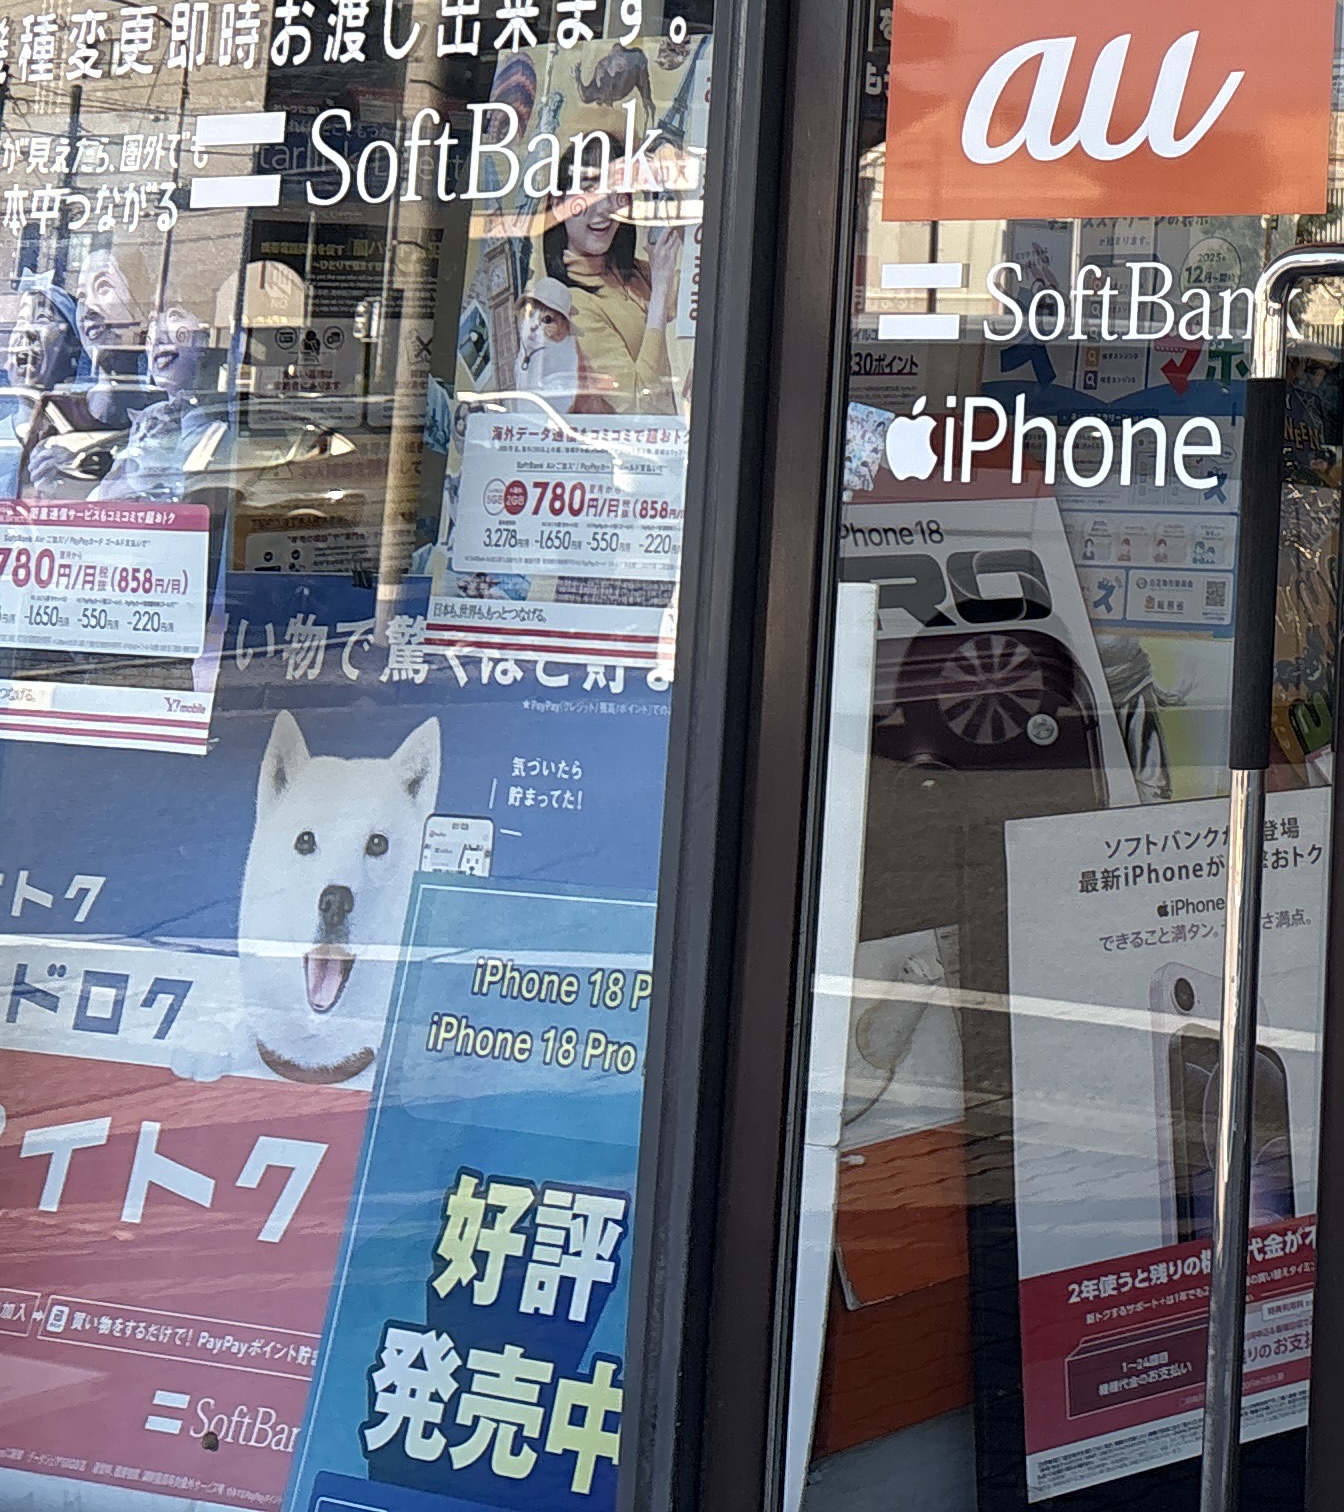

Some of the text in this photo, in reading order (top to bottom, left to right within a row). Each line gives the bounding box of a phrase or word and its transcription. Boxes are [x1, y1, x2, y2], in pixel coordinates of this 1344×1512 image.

[960, 30, 1246, 165] au
[304, 97, 665, 208] SoftBank
[850, 351, 919, 374] 30ポイント
[943, 391, 1223, 489] iPhone
[915, 519, 945, 545] 18
[433, 602, 548, 624] 日本も、世界も、もっとつなげる。
[511, 756, 583, 780] 気づいたら
[508, 785, 583, 810] 貯まってた!
[1103, 817, 1300, 859] ソフトバンク登場
[1078, 843, 1323, 894] 最新iPhoneがおトク
[0, 870, 107, 924] トク
[5, 962, 194, 1041] ドロク
[470, 954, 579, 1003] iPhone
[586, 969, 625, 1009] 18
[425, 1012, 638, 1076] iPhone 18 Pro
[20, 1115, 329, 1244] イトク
[434, 1174, 627, 1321] 好評
[1067, 1225, 1317, 1305] 2年使うと残りの代金が
[0, 1301, 26, 1322] 加入
[70, 1311, 193, 1347] 買い物をするだけで!
[364, 1327, 624, 1494] 発売中
